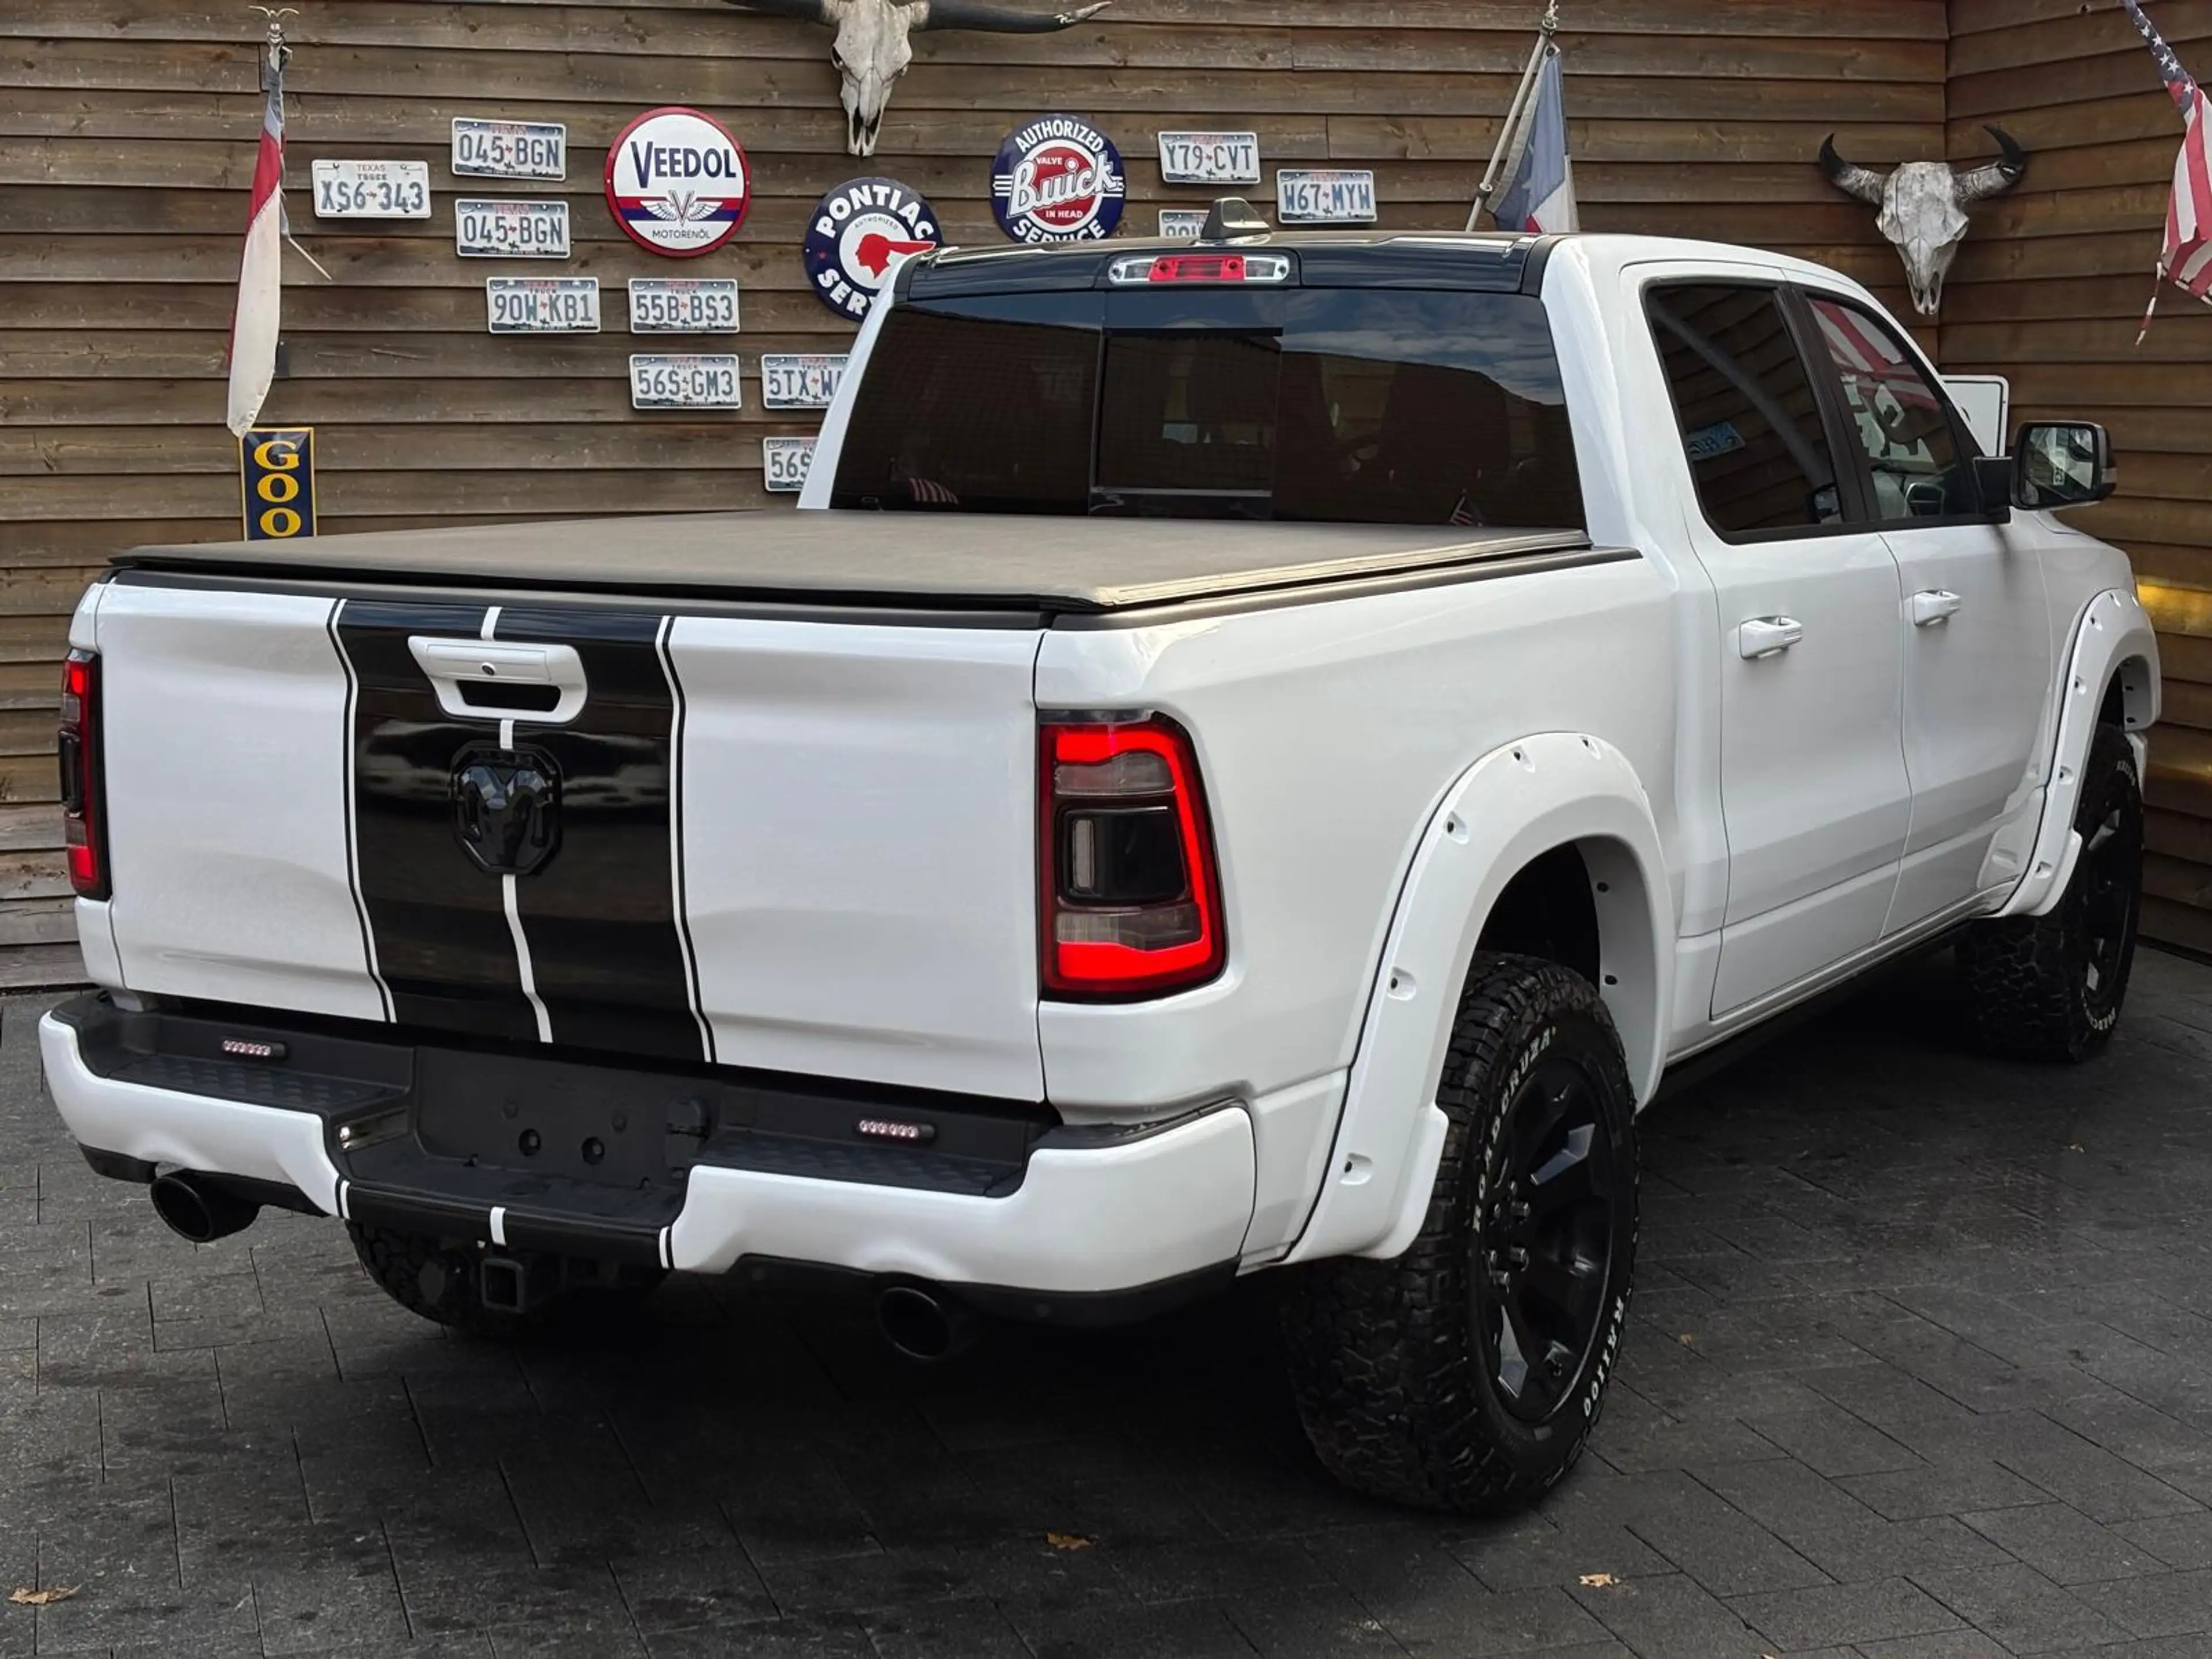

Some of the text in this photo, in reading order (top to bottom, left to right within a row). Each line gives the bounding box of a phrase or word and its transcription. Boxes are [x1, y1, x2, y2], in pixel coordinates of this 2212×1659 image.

[1015, 119, 1104, 153] AUTHORIZED
[459, 134, 559, 168] 045 BGN
[630, 141, 737, 188] VEEDOL
[1036, 157, 1063, 166] VALVE
[1166, 145, 1252, 171] Y79 CVT
[320, 180, 423, 211] XS6 343
[1006, 150, 1116, 219] Buick
[1284, 183, 1321, 211] W67
[815, 184, 934, 239] PONTIAC
[1046, 210, 1084, 218] IN HEAD
[464, 214, 562, 245] 045 BGN
[652, 229, 711, 239] MOTORENÖL
[817, 268, 877, 315] SER
[548, 294, 593, 321] KB1
[636, 294, 680, 321] 55B
[691, 370, 733, 397] GM3
[768, 369, 842, 396] 5TX W
[254, 440, 302, 537] GOO
